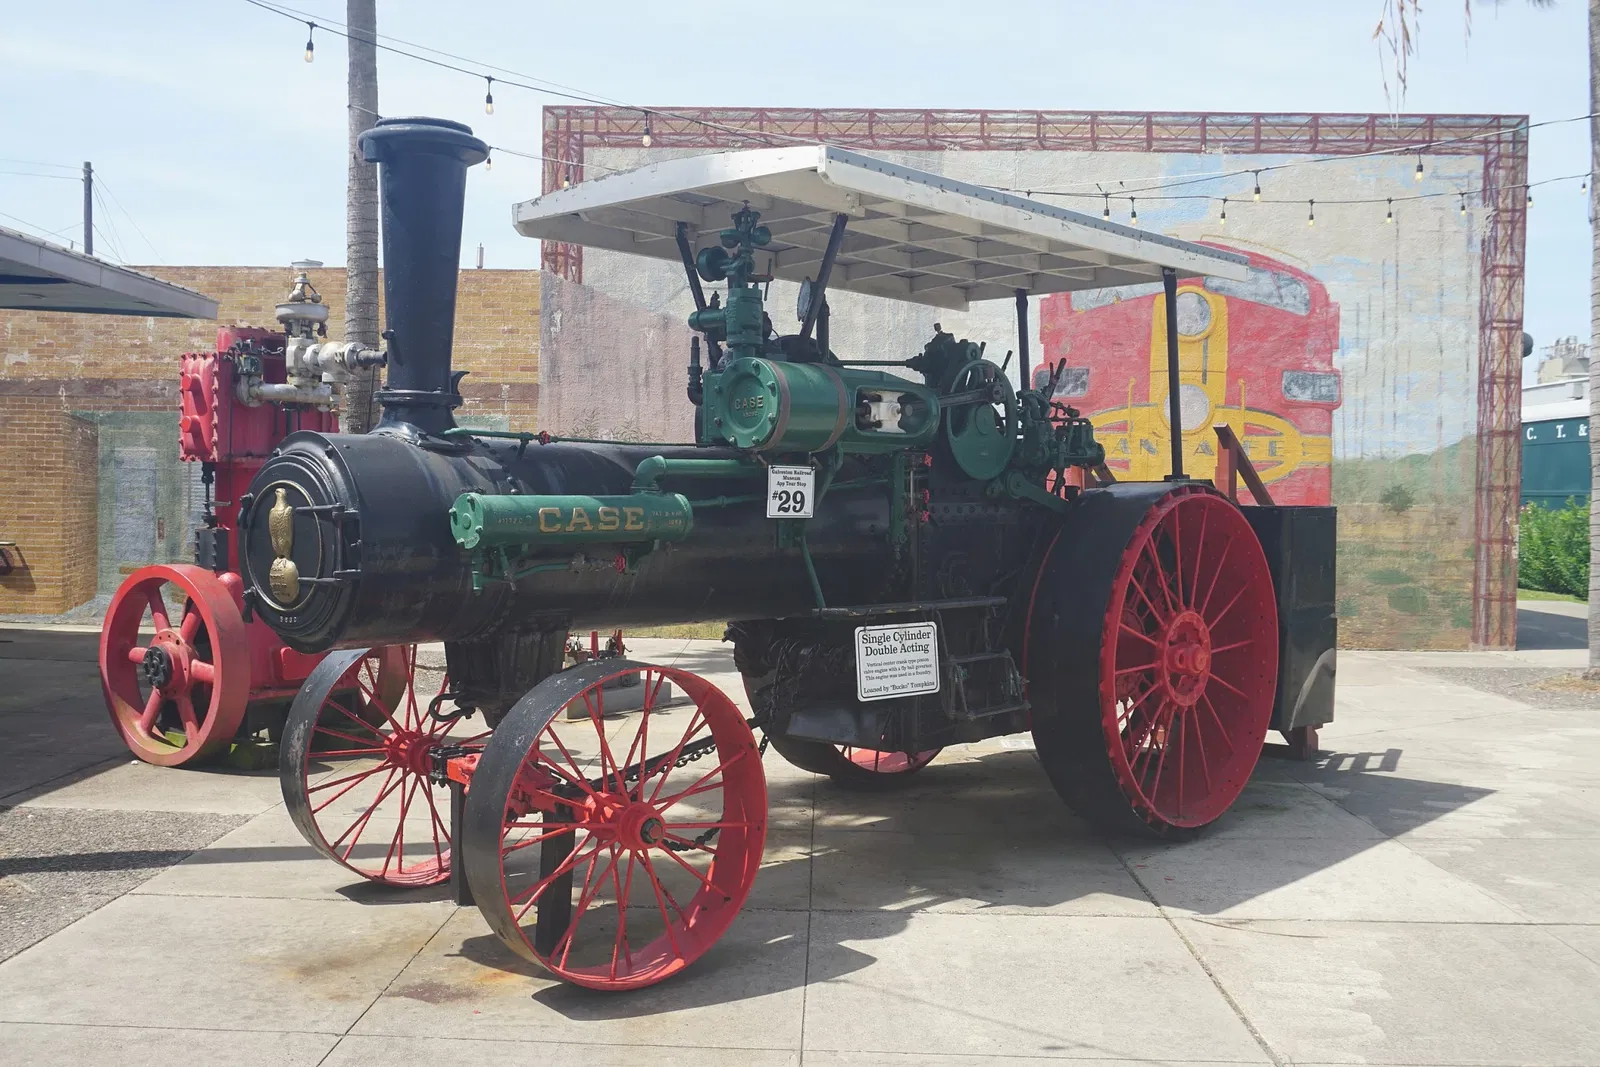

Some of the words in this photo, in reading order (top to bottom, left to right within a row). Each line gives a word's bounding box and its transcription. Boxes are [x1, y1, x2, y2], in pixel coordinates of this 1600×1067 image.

[735, 395, 764, 410] CASE
[1526, 427, 1537, 440] C.
[1556, 424, 1566, 438] T.
[771, 490, 806, 513] #29
[538, 507, 645, 533] CASE
[861, 633, 891, 646] Single
[893, 629, 931, 644] Cylinder
[865, 644, 898, 657] Double
[899, 642, 930, 654] Acting
[910, 680, 935, 688] Tompkins
